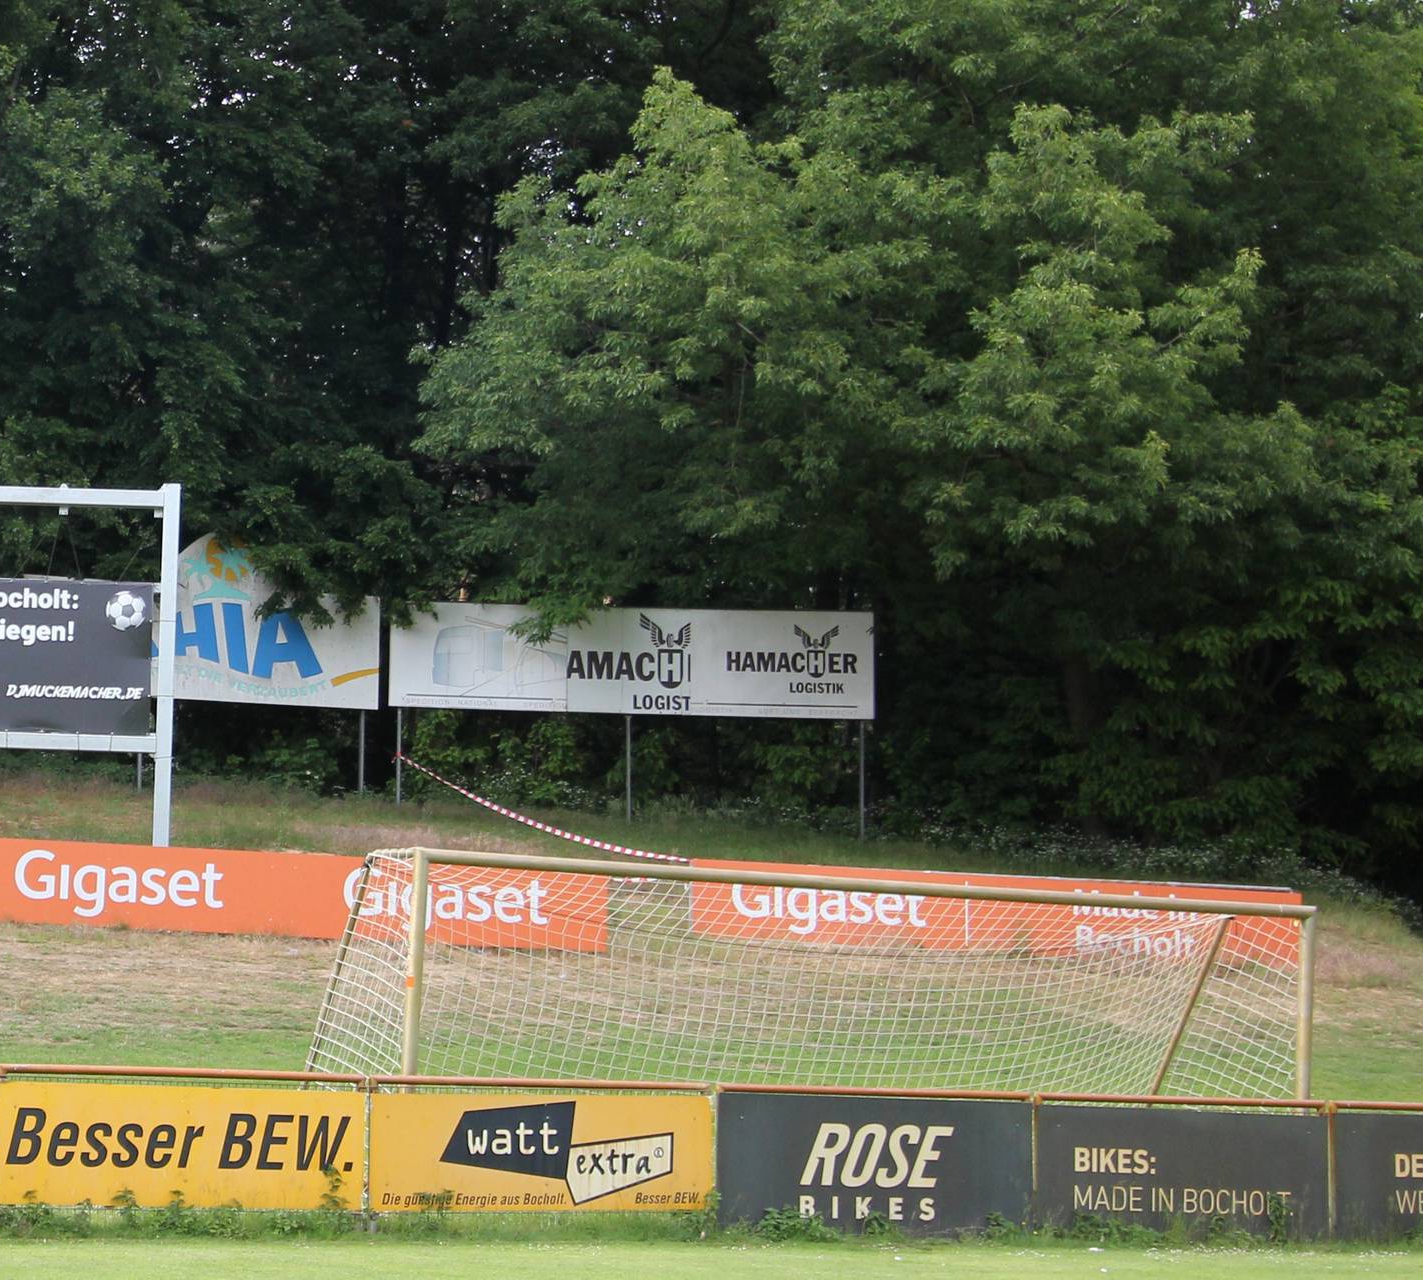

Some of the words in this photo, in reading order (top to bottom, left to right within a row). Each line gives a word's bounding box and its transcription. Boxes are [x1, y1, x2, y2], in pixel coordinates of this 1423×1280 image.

[152, 603, 323, 679] HIA
[727, 650, 858, 678] HAMACHER
[5, 683, 145, 700] DJMUCKEMACHER.DE
[789, 681, 844, 694] LOGISTIK
[633, 694, 691, 711] LOGIST
[13, 849, 224, 918] Gigaset
[343, 866, 549, 931] Gigaset
[5, 1106, 205, 1169] Besser
[218, 1112, 354, 1172] BEW.
[467, 1121, 560, 1156] watt
[799, 1122, 955, 1189] ROSE
[1074, 1147, 1157, 1176] BIKES:
[1395, 1153, 1423, 1178] DE
[382, 1192, 402, 1206] Die
[455, 1192, 497, 1209] Energie
[500, 1196, 519, 1206] aus
[634, 1192, 671, 1205] Besser
[673, 1192, 702, 1205] BEW.
[799, 1195, 936, 1221] BIKES
[1074, 1185, 1144, 1213] MADE
[1151, 1187, 1174, 1214] IN
